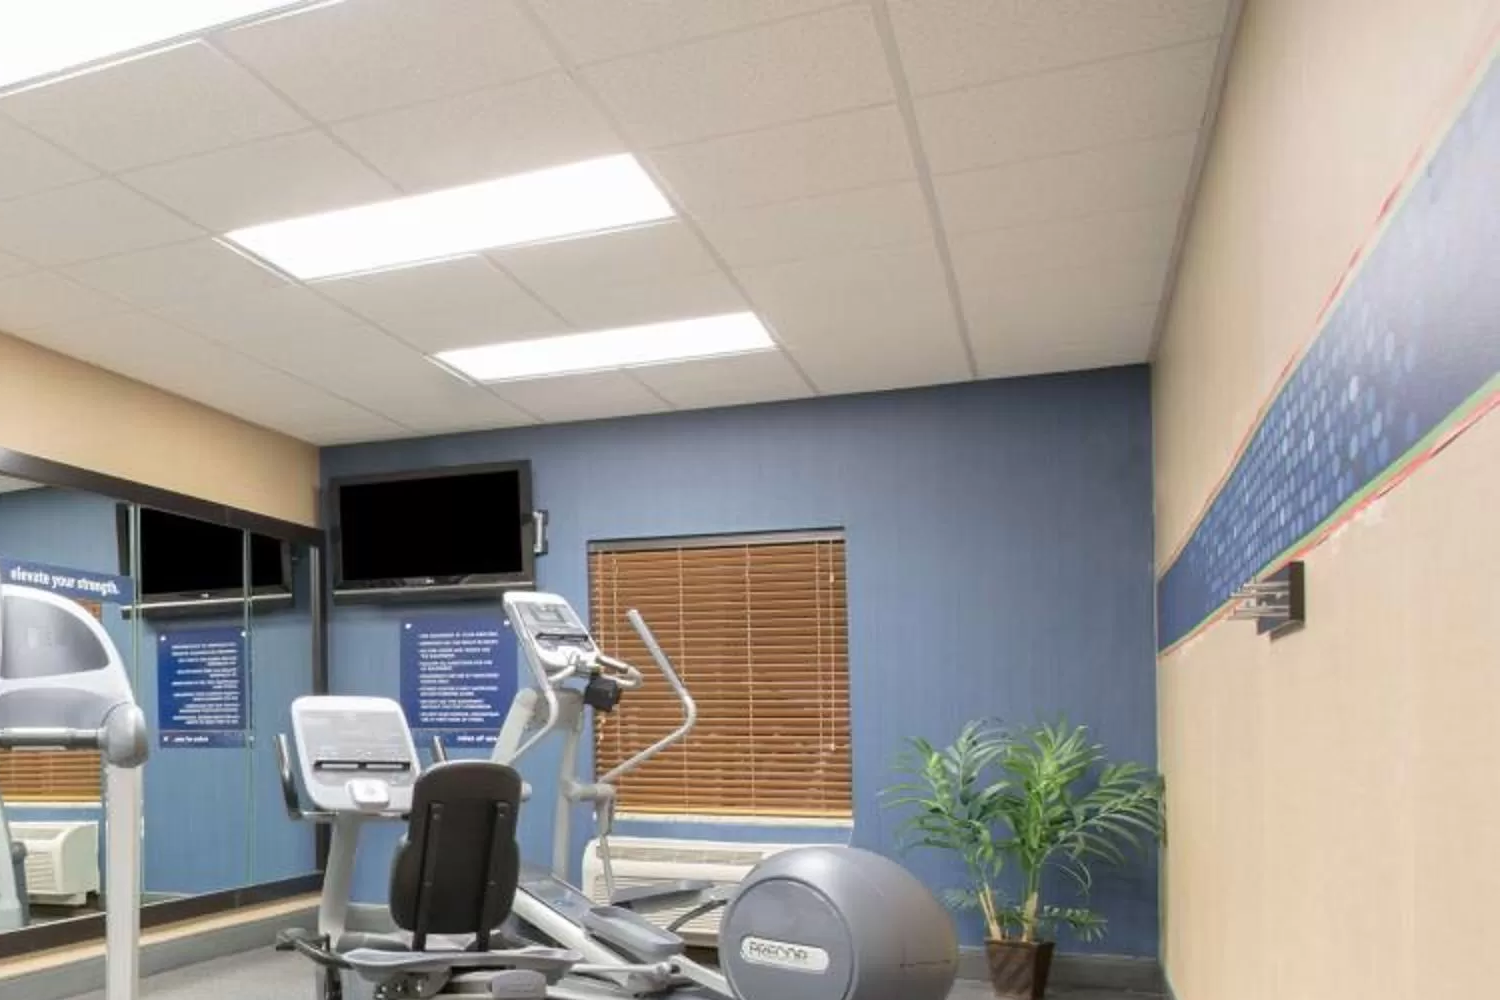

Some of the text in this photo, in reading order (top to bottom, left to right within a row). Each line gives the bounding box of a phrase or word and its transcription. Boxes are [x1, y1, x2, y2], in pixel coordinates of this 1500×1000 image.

[10, 565, 120, 596] elevate your strength.
